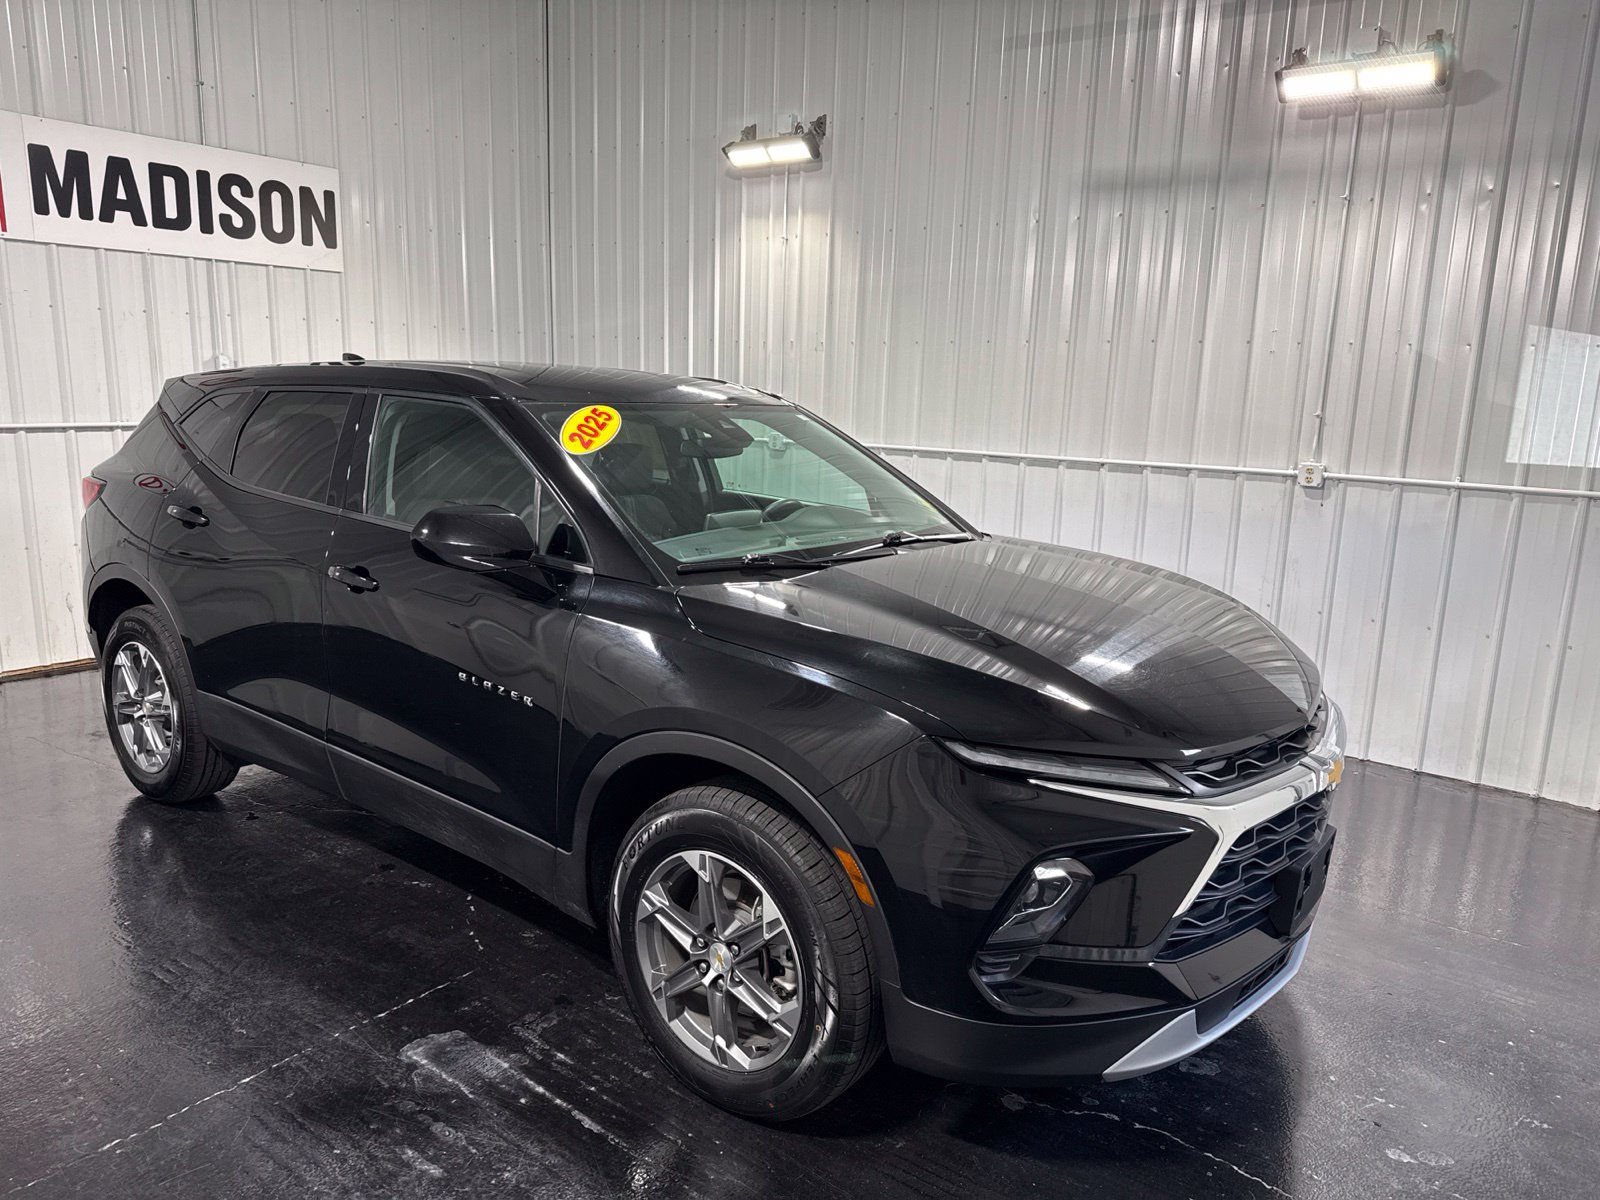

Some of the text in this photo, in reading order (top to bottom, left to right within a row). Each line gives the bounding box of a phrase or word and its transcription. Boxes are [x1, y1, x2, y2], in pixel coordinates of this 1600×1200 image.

[27, 143, 338, 249] MADISON
[569, 408, 613, 450] 2025
[458, 671, 534, 707] BLAZER
